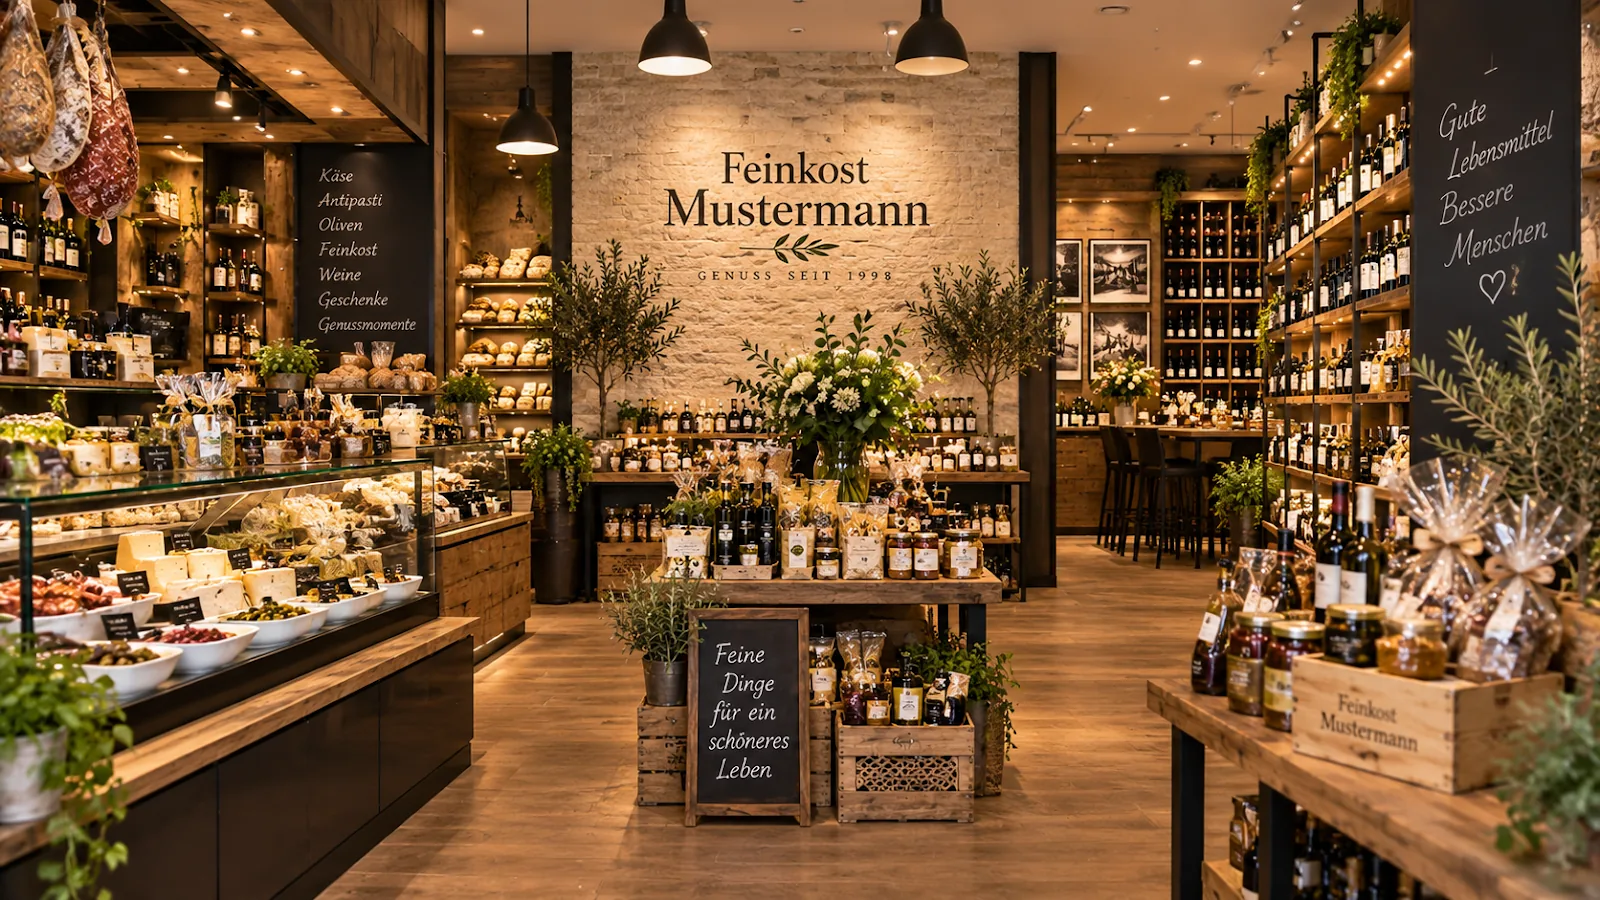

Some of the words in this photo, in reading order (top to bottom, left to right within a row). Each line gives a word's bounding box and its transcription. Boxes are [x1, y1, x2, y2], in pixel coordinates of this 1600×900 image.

[1439, 99, 1487, 141] Gute
[1447, 109, 1554, 180] Lebensmittel
[318, 167, 354, 183] Käse
[721, 151, 869, 184] Feinkost
[318, 192, 383, 210] Antipasti
[664, 189, 929, 227] Mustermann
[1439, 183, 1514, 226] Bessere
[318, 216, 363, 232] Oliven
[318, 241, 378, 257] Feinkost
[1443, 216, 1549, 268] Menschen
[319, 266, 362, 282] Weine
[698, 270, 772, 281] GENUSS
[788, 270, 831, 281] SEIT
[848, 270, 892, 281] 1998
[318, 290, 389, 309] Geschenke
[318, 316, 417, 334] Genussmomente
[715, 642, 765, 666] Feine
[721, 671, 775, 700] Dinge
[708, 700, 742, 729] für
[748, 702, 777, 721] ein
[1338, 692, 1397, 724] Feinkost
[708, 728, 790, 751] schöneres
[1320, 710, 1418, 753] Mustermann
[715, 756, 773, 780] Leben
